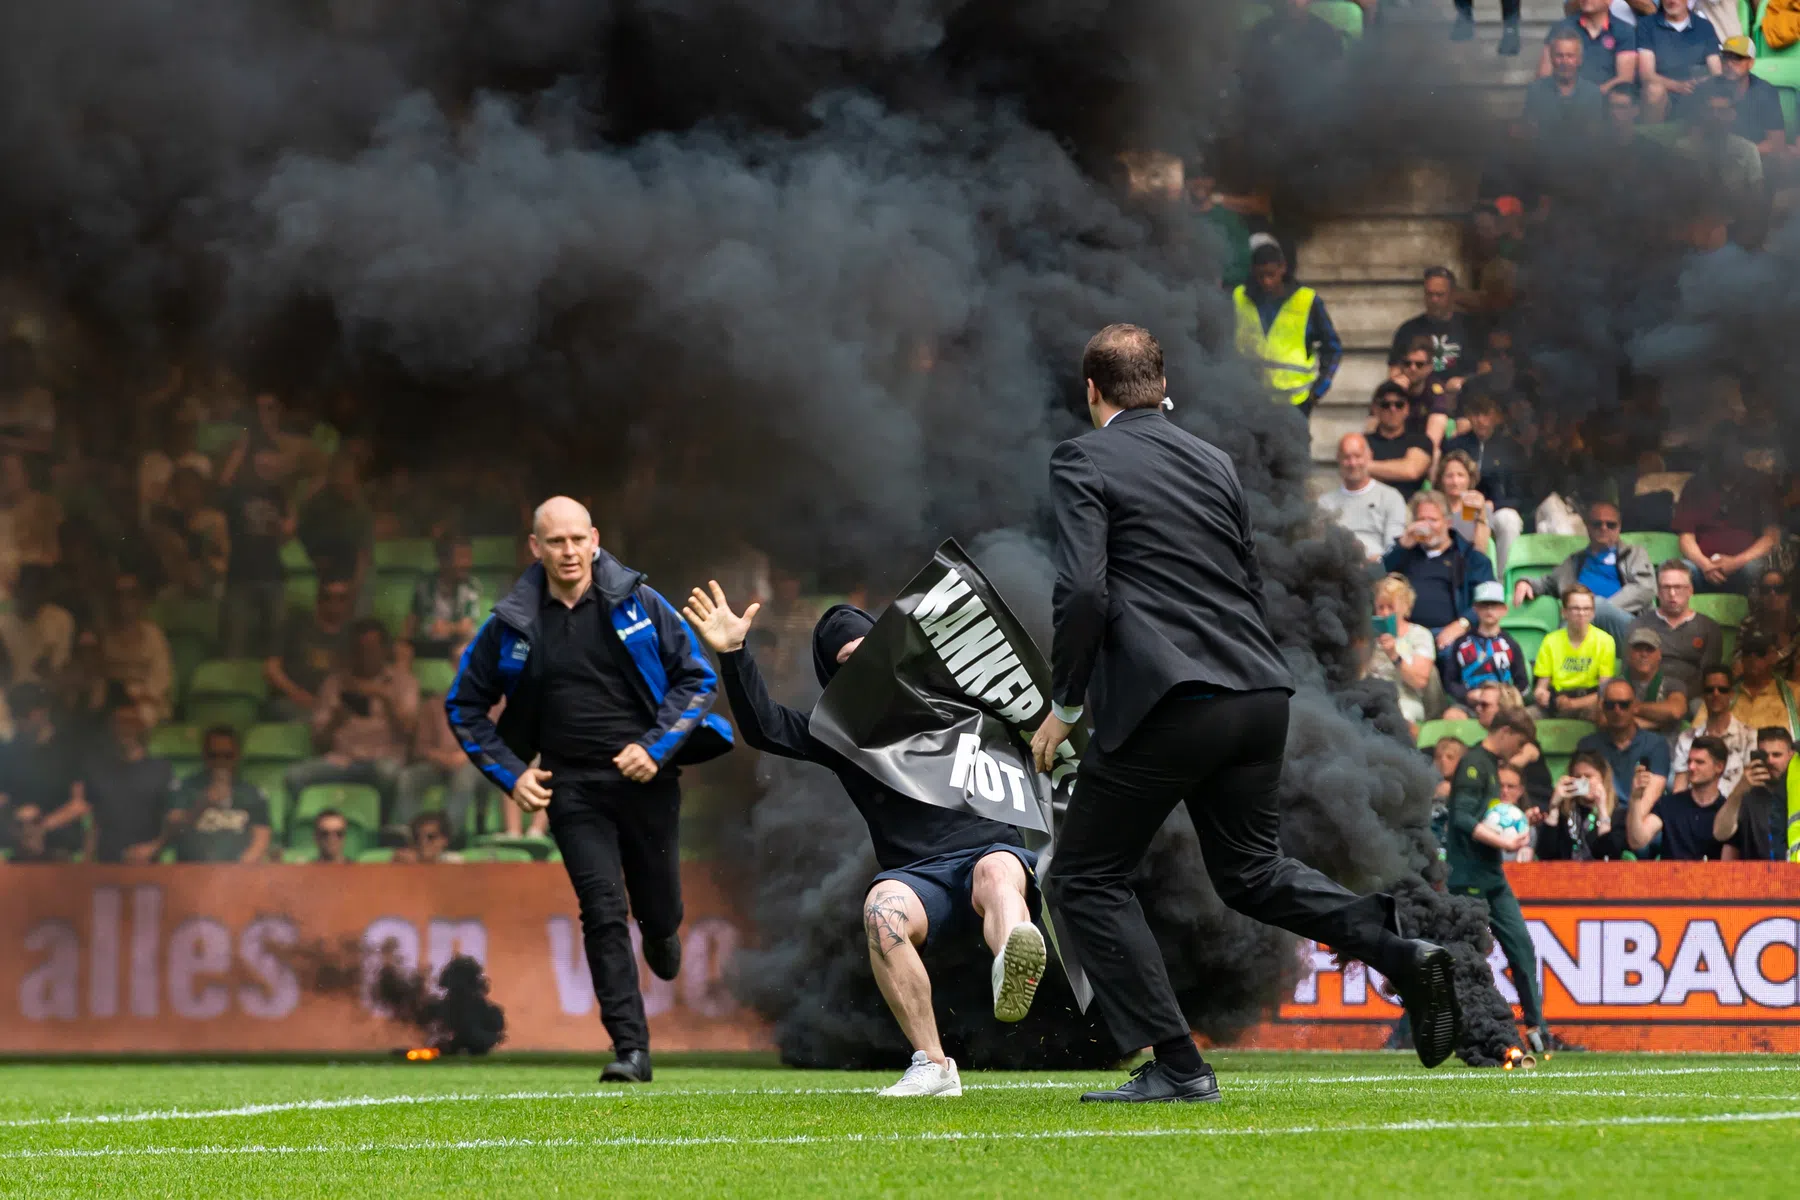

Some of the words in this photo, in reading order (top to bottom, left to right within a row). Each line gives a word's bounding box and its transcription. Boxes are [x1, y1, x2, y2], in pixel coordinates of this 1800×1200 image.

[912, 567, 1044, 724] KANKER
[949, 733, 1026, 812] ROT
[18, 885, 303, 1021] alles
[1293, 917, 1800, 1006] HNBAC
